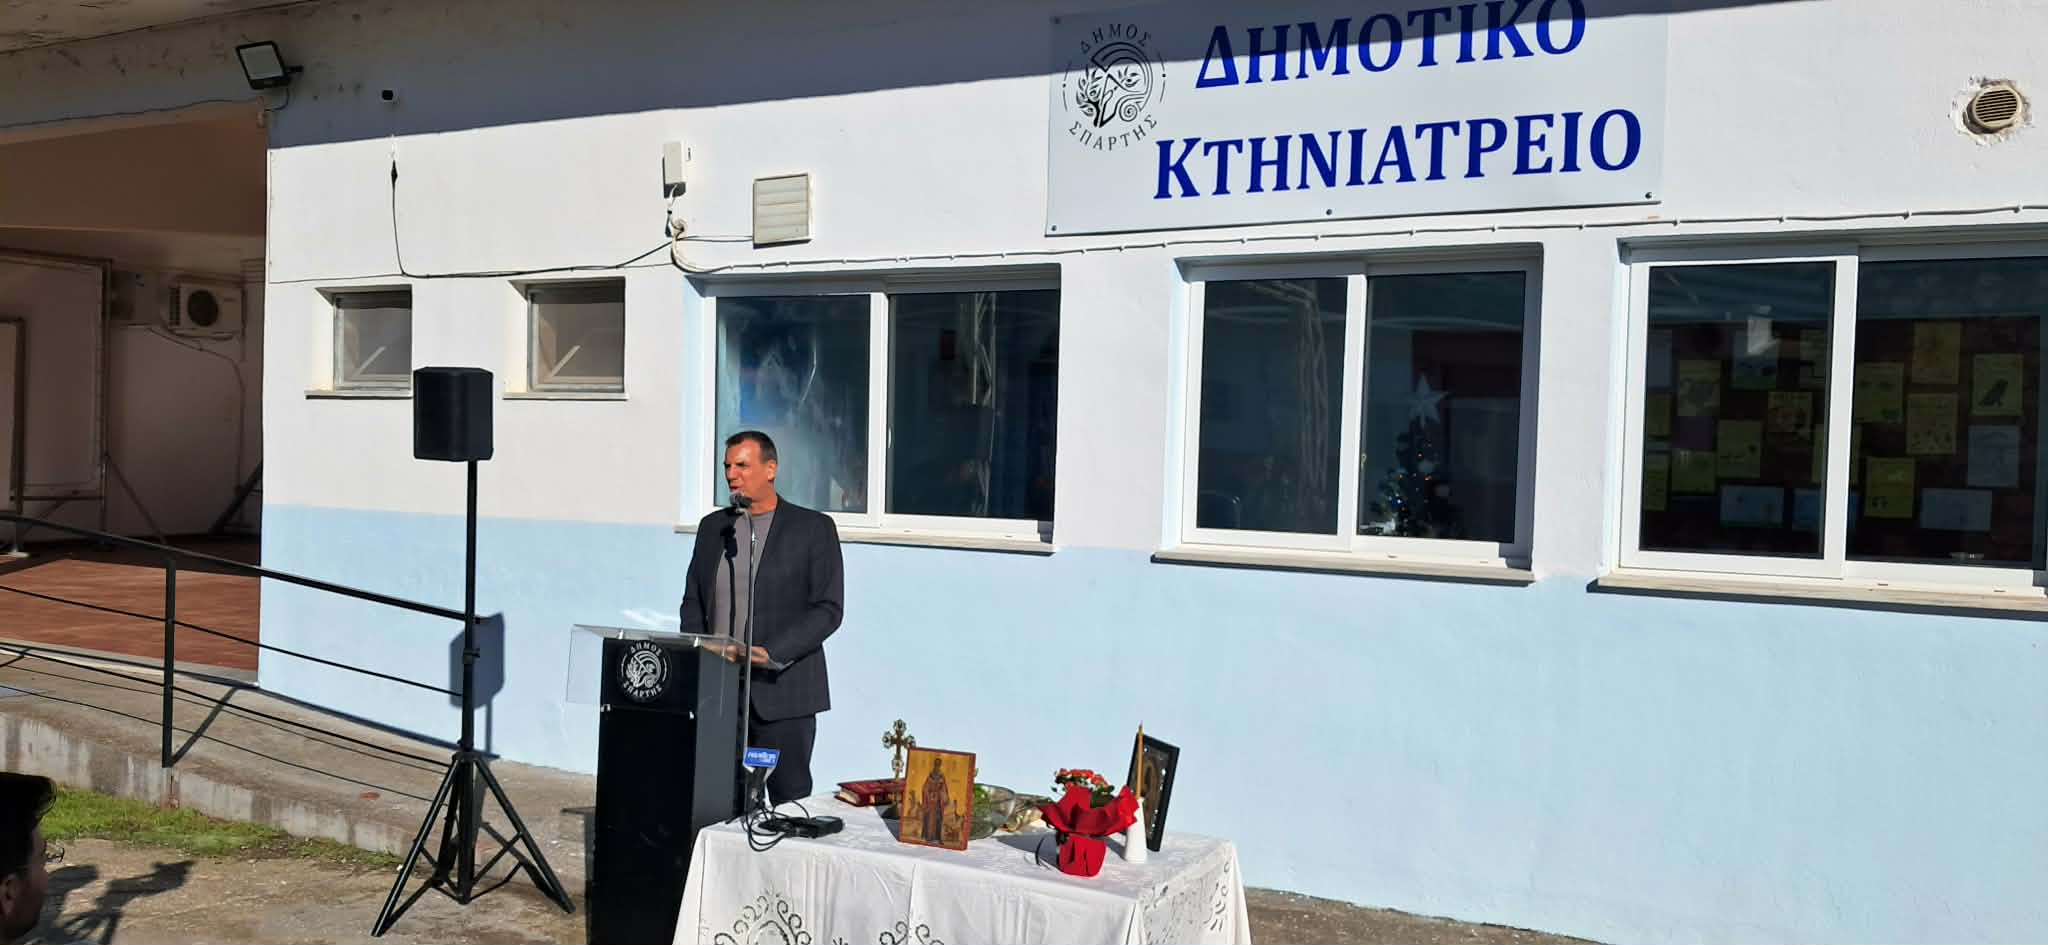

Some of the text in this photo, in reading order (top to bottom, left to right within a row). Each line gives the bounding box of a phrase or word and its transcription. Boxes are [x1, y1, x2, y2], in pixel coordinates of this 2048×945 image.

[1080, 23, 1152, 54] ΔΗΜΟΣ
[1196, 0, 1586, 88] ΔΗΜΟΤΙΚΟ
[1069, 114, 1158, 151] ΣΠΑΡΤΗΣ
[1153, 109, 1641, 199] ΚΤΗΝΙΑΤΡΕΙΟ
[630, 641, 662, 656] ΔΗΜΟΣ
[623, 680, 663, 697] ΣΠΑΡΤΗΣ
